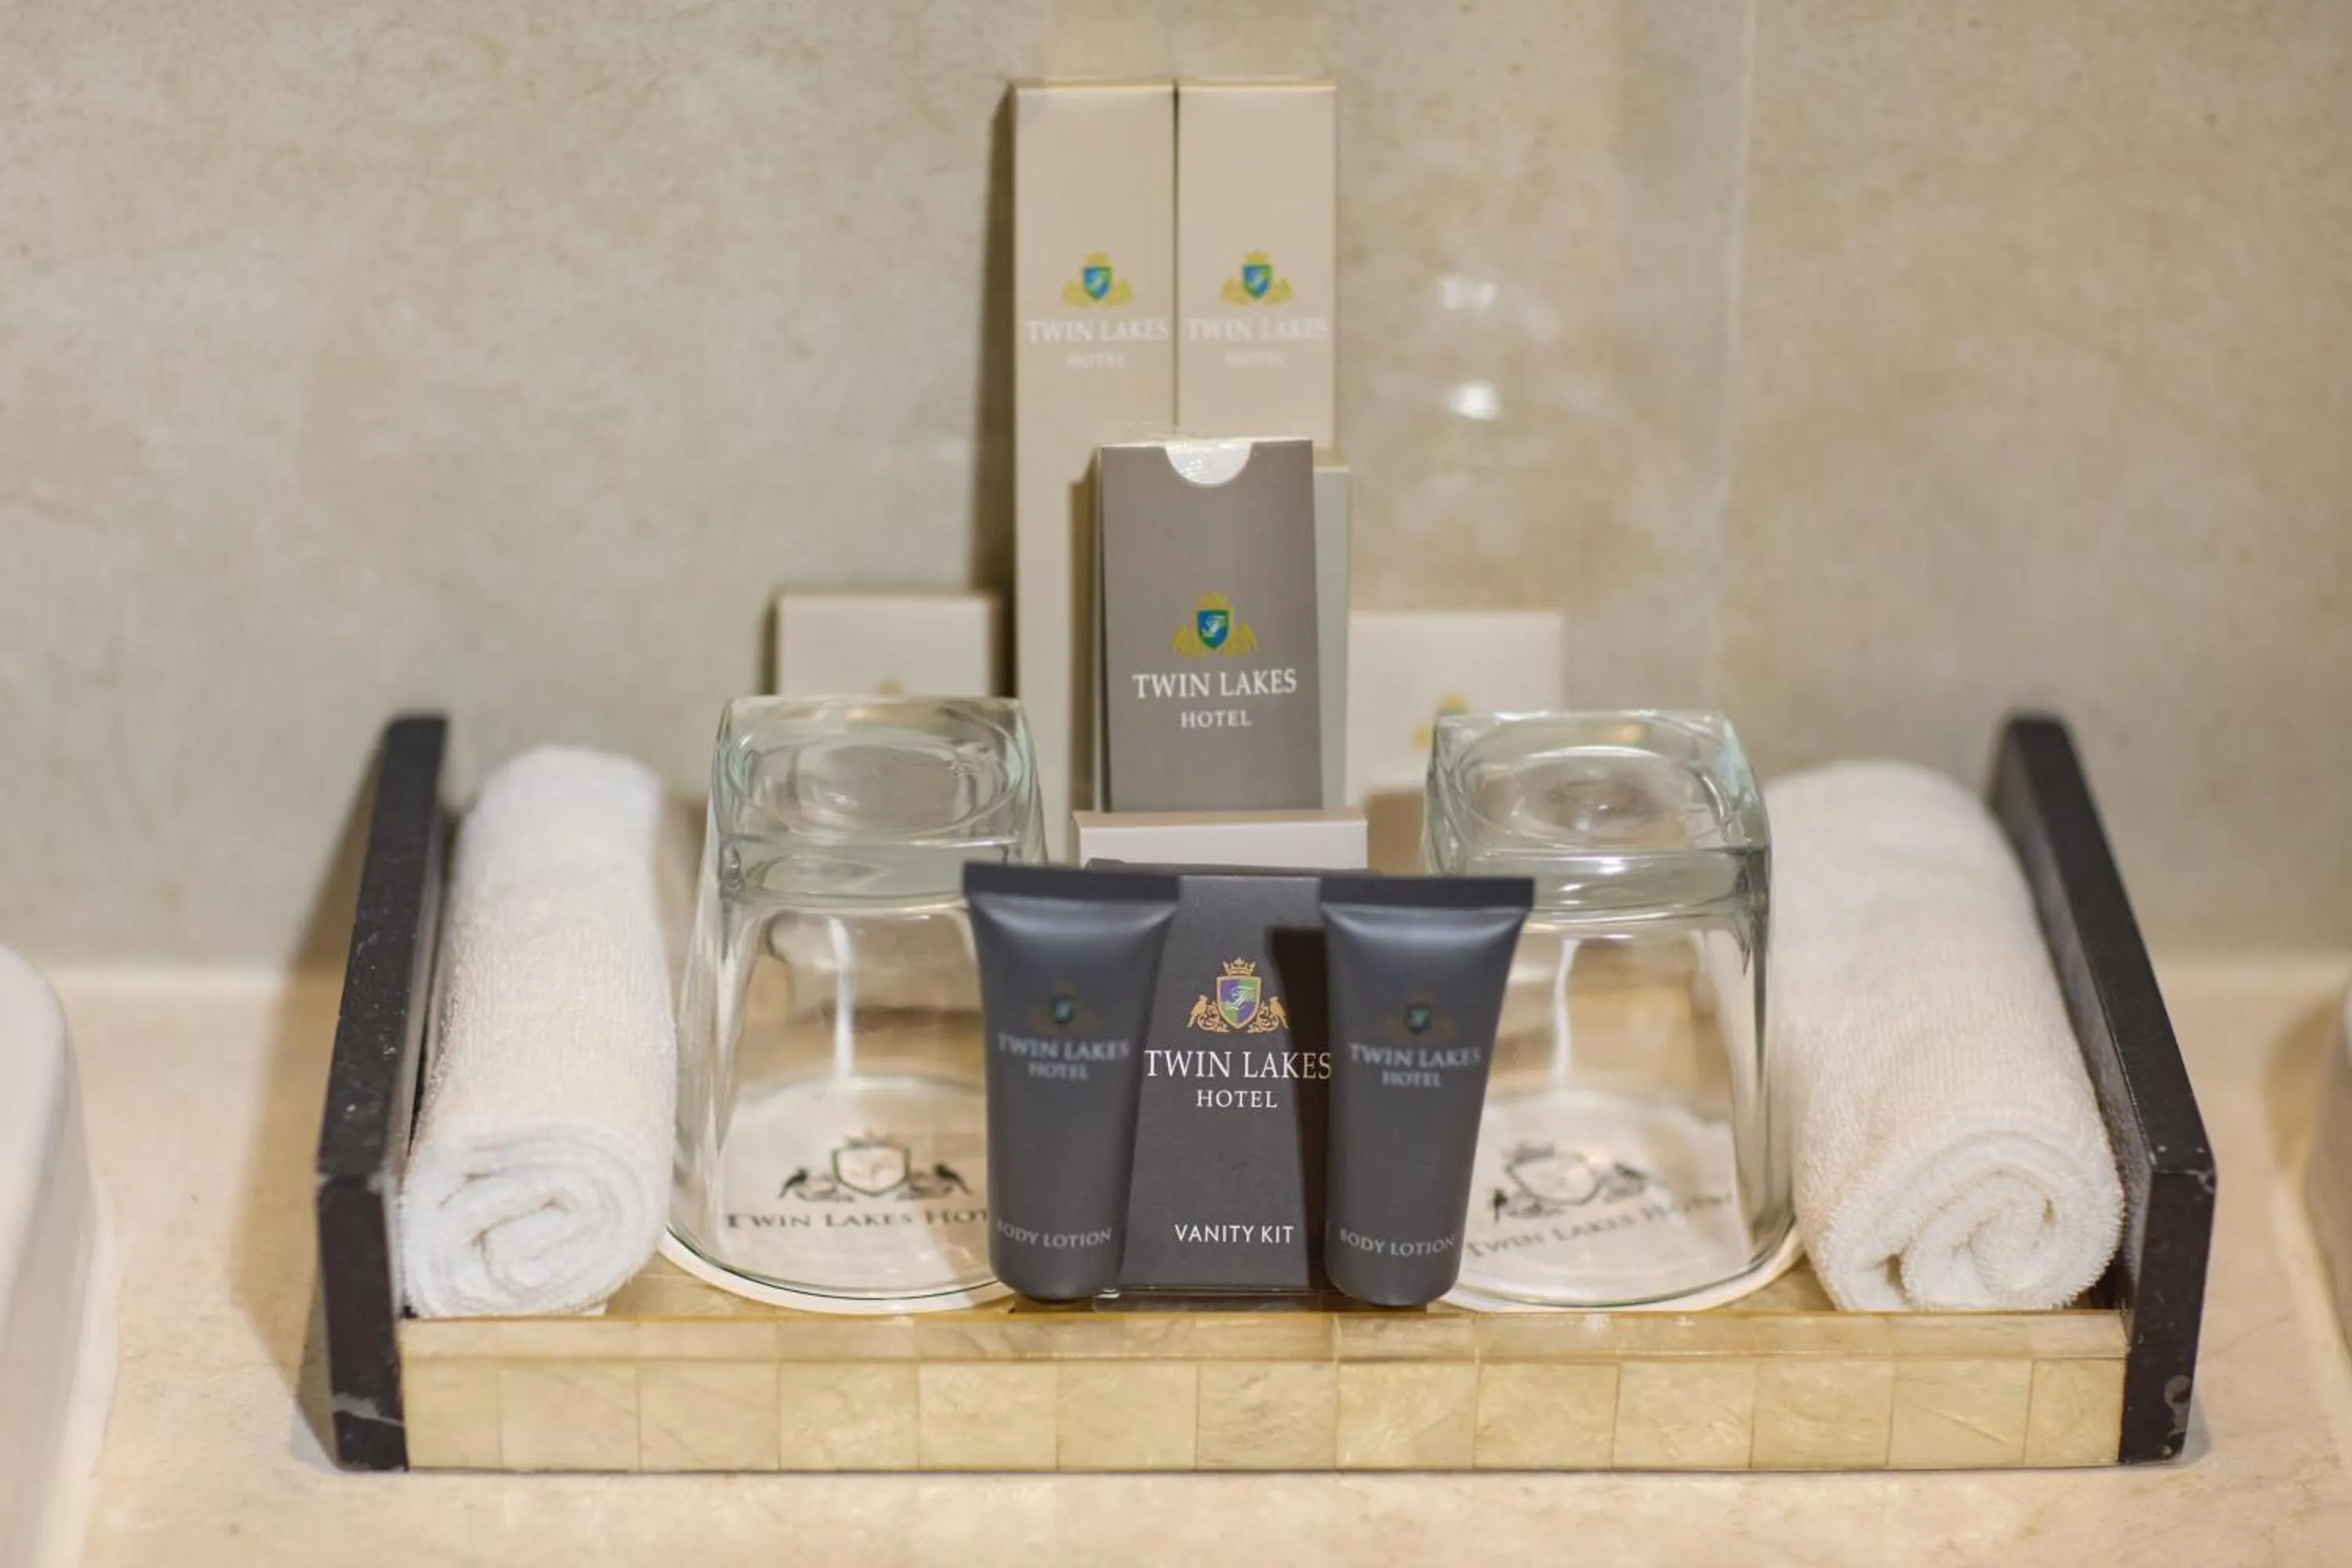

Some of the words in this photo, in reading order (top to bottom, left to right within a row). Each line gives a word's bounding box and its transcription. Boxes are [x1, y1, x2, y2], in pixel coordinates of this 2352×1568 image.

[1026, 320, 1093, 343] TWIN
[1101, 318, 1168, 341] LAKES
[1185, 318, 1252, 341] TWIN
[1261, 318, 1329, 339] LAKES
[1131, 672, 1210, 699] TWIN
[1220, 668, 1298, 697] LAKES
[1180, 709, 1252, 728] HOTEL
[996, 1032, 1058, 1058] TWIN
[1064, 1039, 1130, 1061] LAKES
[1347, 1042, 1411, 1067] TWIN
[1417, 1046, 1483, 1069] LAKES
[1028, 1062, 1089, 1081] HOTEL
[1144, 1050, 1232, 1078] TWIN
[1242, 1051, 1332, 1080] LAKES
[1381, 1069, 1442, 1087] HOTEL
[1196, 1089, 1277, 1109] HOTEL
[728, 1213, 811, 1229] TWIN
[825, 1213, 913, 1228] LAKES
[926, 1208, 988, 1224] HOT
[1043, 1227, 1112, 1248] LOTION
[1174, 1224, 1254, 1243] VANITY
[1261, 1225, 1294, 1243] KIT
[1340, 1228, 1385, 1254] BODY
[1390, 1234, 1455, 1256] LOTION
